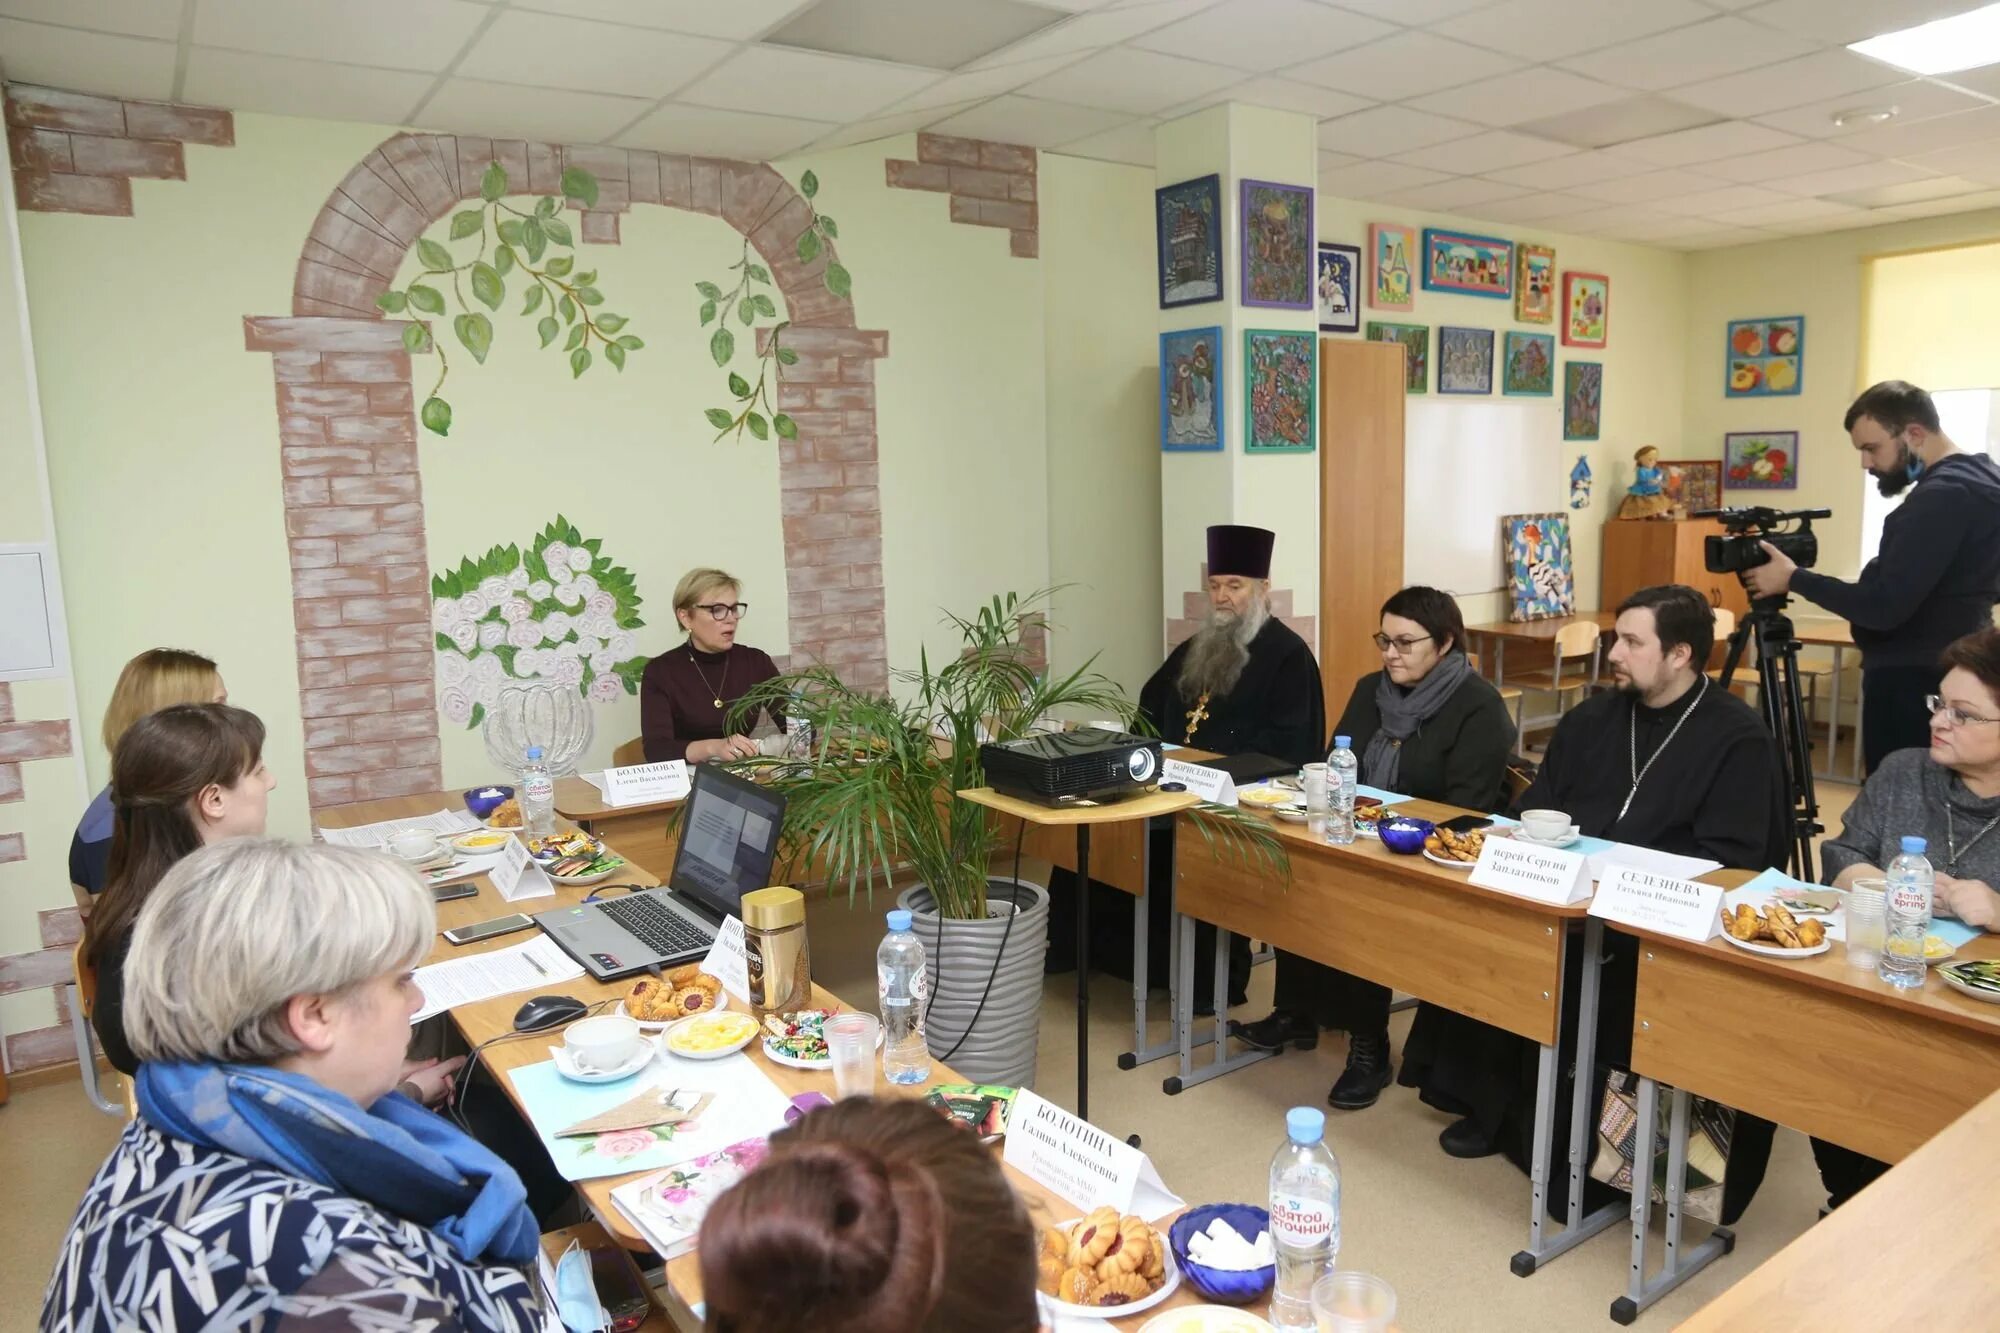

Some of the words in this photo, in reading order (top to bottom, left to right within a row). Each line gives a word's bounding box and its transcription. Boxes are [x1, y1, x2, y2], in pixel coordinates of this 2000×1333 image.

[1173, 763, 1218, 779] БОРИСЕНКО
[1491, 861, 1560, 886] Заплатников
[1527, 854, 1568, 871] Сергий
[1616, 883, 1652, 899] Татьяна
[1654, 892, 1701, 909] Ивановна
[1621, 870, 1701, 897] СЕЛЕЗНЕВА
[1037, 1103, 1113, 1157] БОЛОТИНА
[1022, 1118, 1057, 1148] Галина
[1060, 1141, 1119, 1184] Алексеевна
